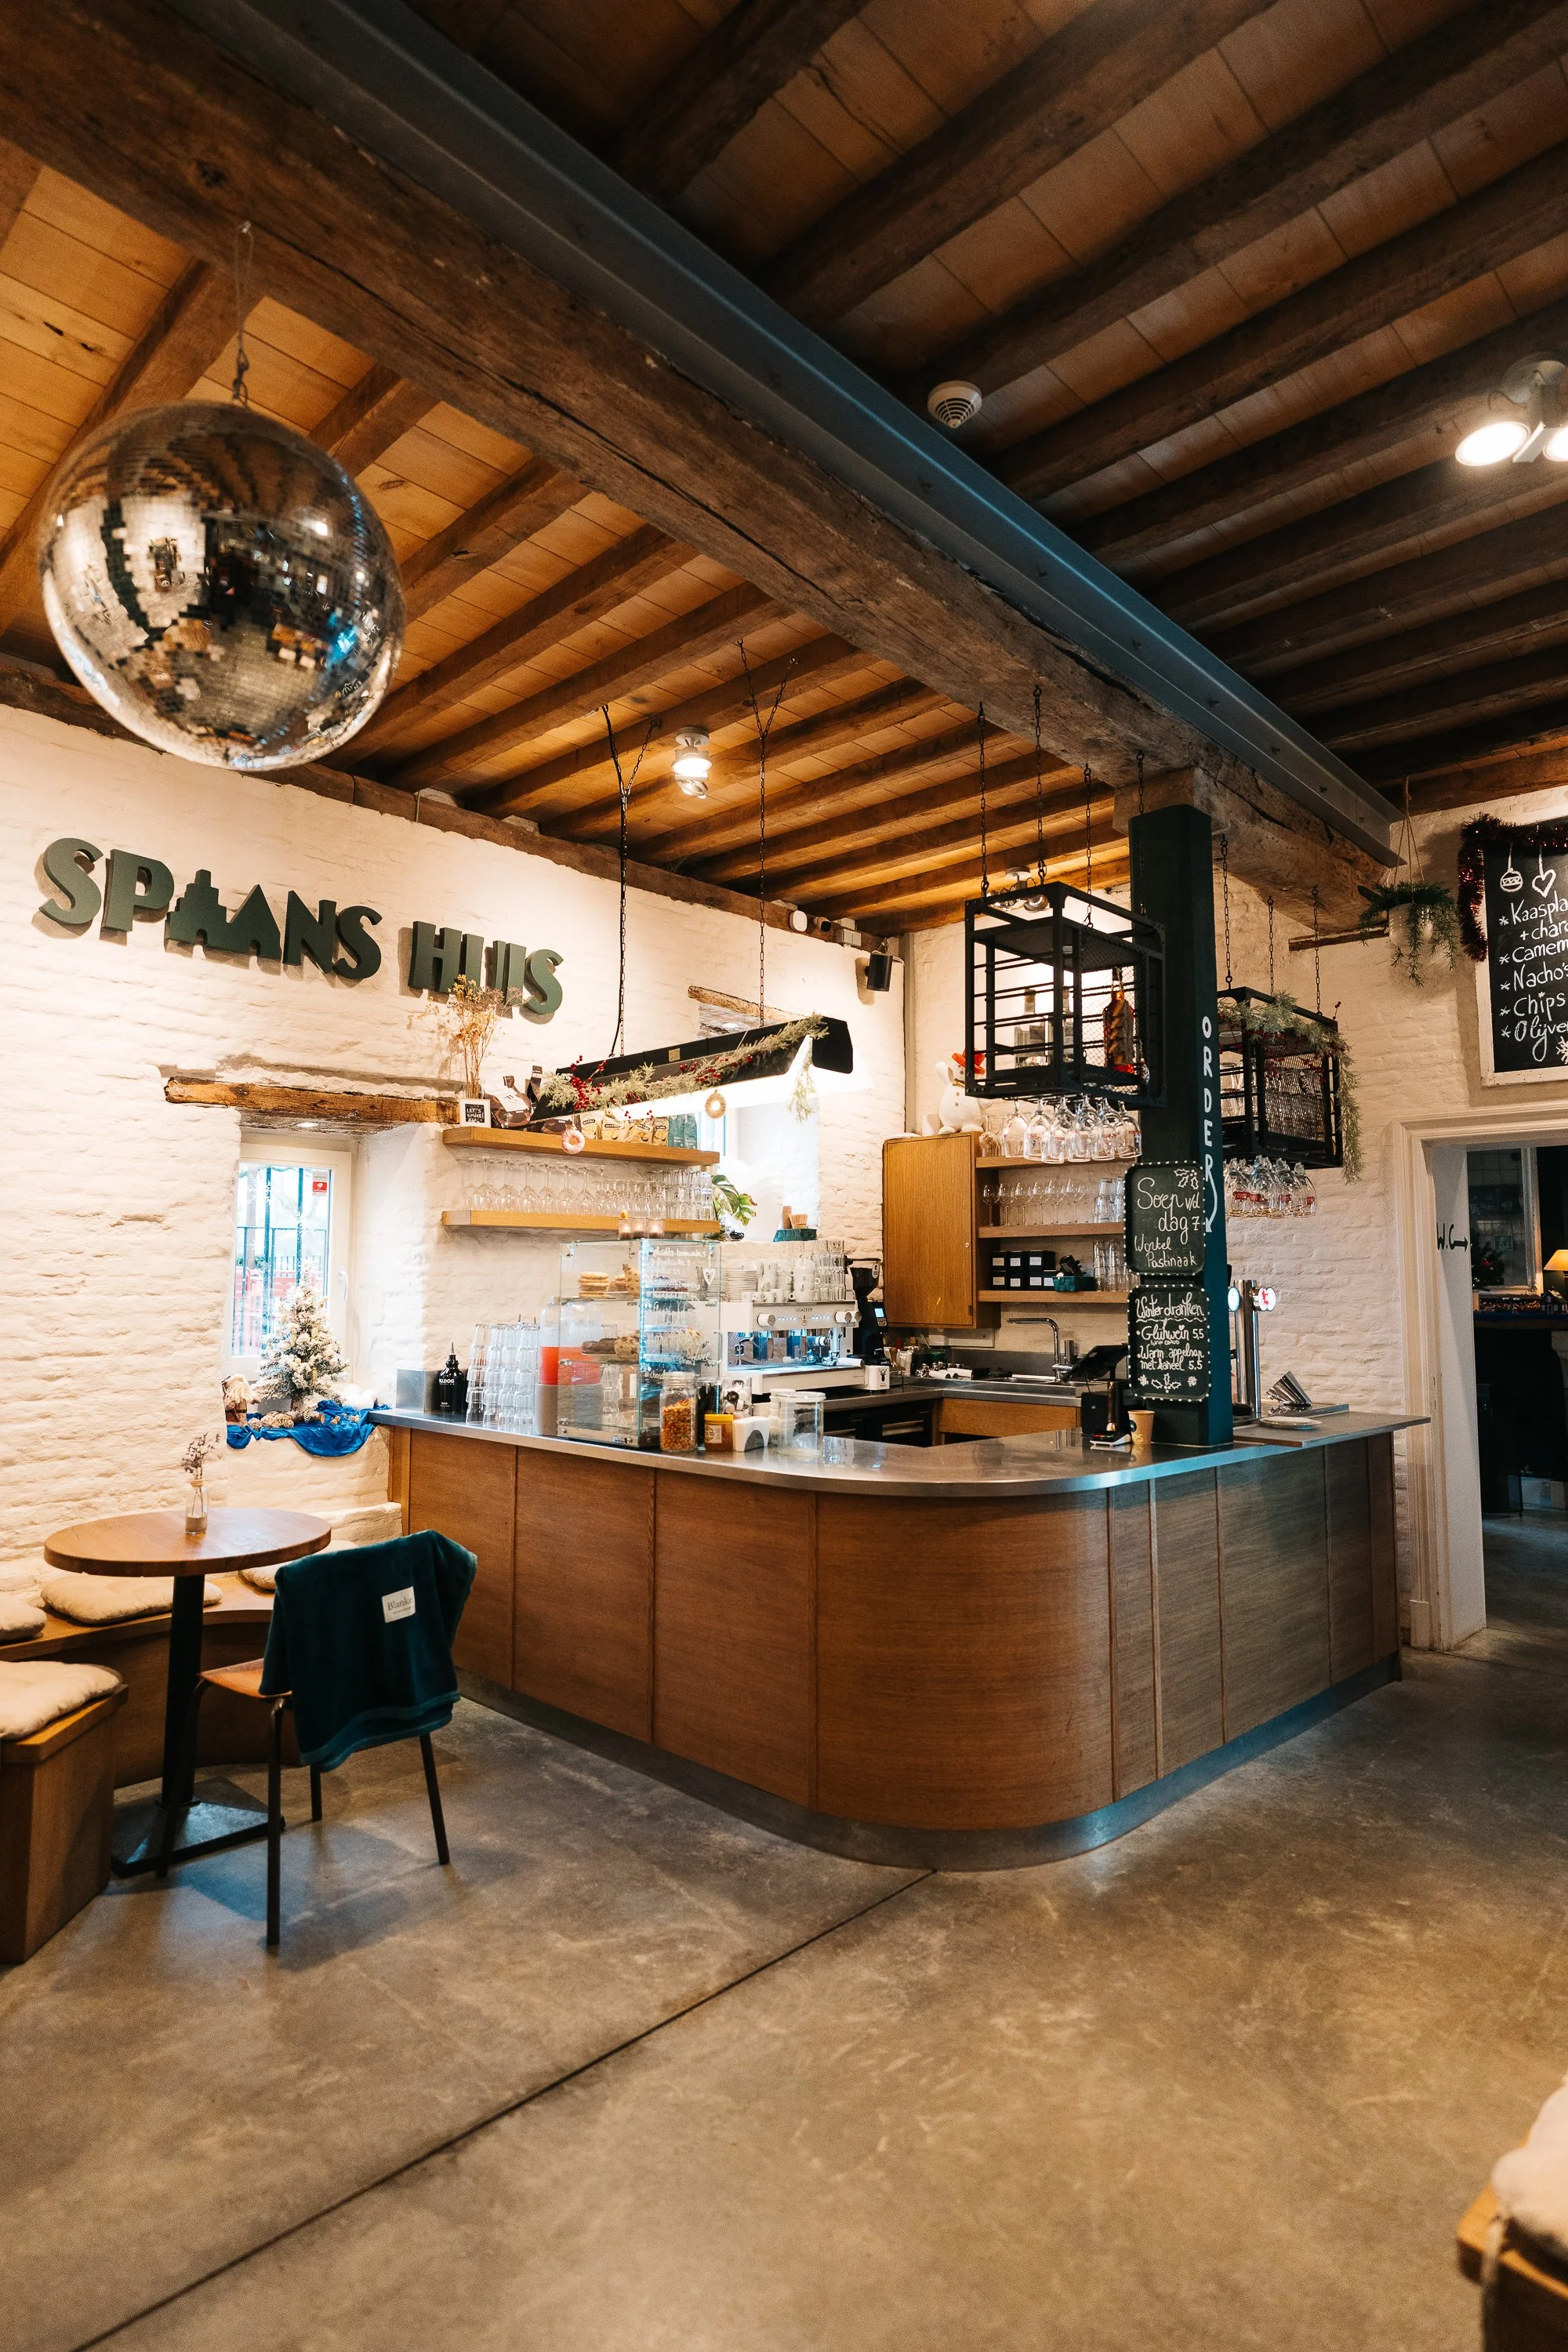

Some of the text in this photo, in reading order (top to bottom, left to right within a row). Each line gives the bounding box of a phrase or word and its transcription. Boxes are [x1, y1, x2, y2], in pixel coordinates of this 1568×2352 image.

[39, 837, 564, 1014] SPAANS HUIS
[1513, 991, 1566, 1022] Chips
[1514, 1014, 1568, 1062] Olijve
[1201, 1015, 1214, 1182] ORDER
[1137, 1177, 1200, 1221] Soep v/d
[1134, 1233, 1172, 1252] Wortel
[1158, 1211, 1189, 1245] dag
[1145, 1250, 1197, 1269] Pastinaak
[1141, 1318, 1190, 1341] Glühwein
[1139, 1359, 1157, 1370] met
[1156, 1356, 1185, 1371] kaneel
[1140, 1342, 1205, 1364] Warm appelsap
